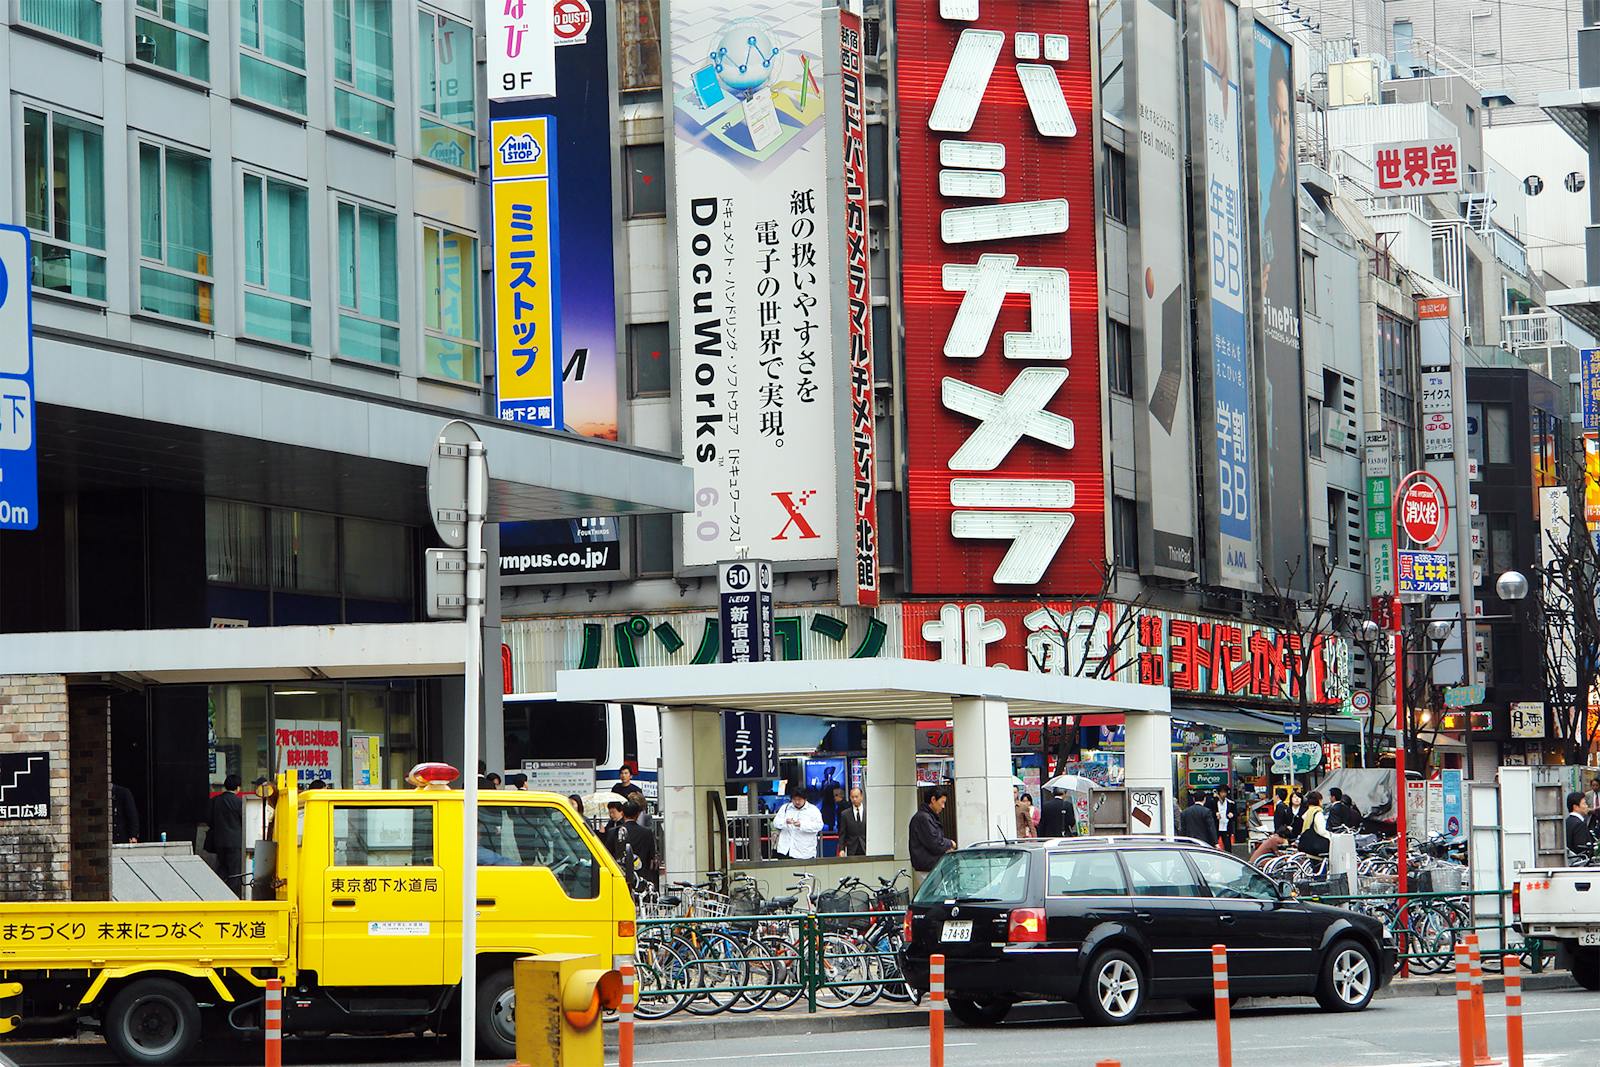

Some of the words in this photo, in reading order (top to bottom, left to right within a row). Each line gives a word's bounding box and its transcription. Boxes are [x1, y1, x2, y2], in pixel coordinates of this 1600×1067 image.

[562, 11, 589, 24] DUST!
[503, 71, 533, 91] 9F
[508, 141, 532, 151] MINI
[1140, 130, 1153, 147] real
[507, 151, 533, 161] STOP
[1376, 143, 1458, 190] 世界堂
[1210, 172, 1239, 240] 年割
[1212, 232, 1240, 296] BB
[510, 203, 539, 377] ミニストップ
[790, 188, 819, 403] 紙の扱いやすさを
[928, 0, 1077, 585] バシカメラ
[690, 197, 723, 463] DocuWorks
[754, 219, 785, 448] 電子の世界で実現。
[1423, 389, 1451, 400] テイクス
[501, 406, 551, 422] 地下2階
[1217, 399, 1247, 464] 学割
[1219, 458, 1248, 521] BB
[696, 487, 720, 541] 6.0
[1406, 501, 1437, 525] 消火栓
[1168, 545, 1191, 564] ThinkPad
[1234, 547, 1247, 569] AOL
[729, 569, 749, 585] 50
[1413, 563, 1448, 581] セキネ
[728, 595, 750, 603] KEIO
[922, 604, 1110, 677] 北館
[1355, 696, 1366, 706] 20
[735, 711, 753, 775] ーミナル
[0, 804, 48, 818] 西口広場
[331, 878, 437, 893] 東京都下水道局
[2, 922, 86, 940] まちづくり
[97, 921, 204, 939] 未来につなぐ
[215, 921, 267, 939] 下水道
